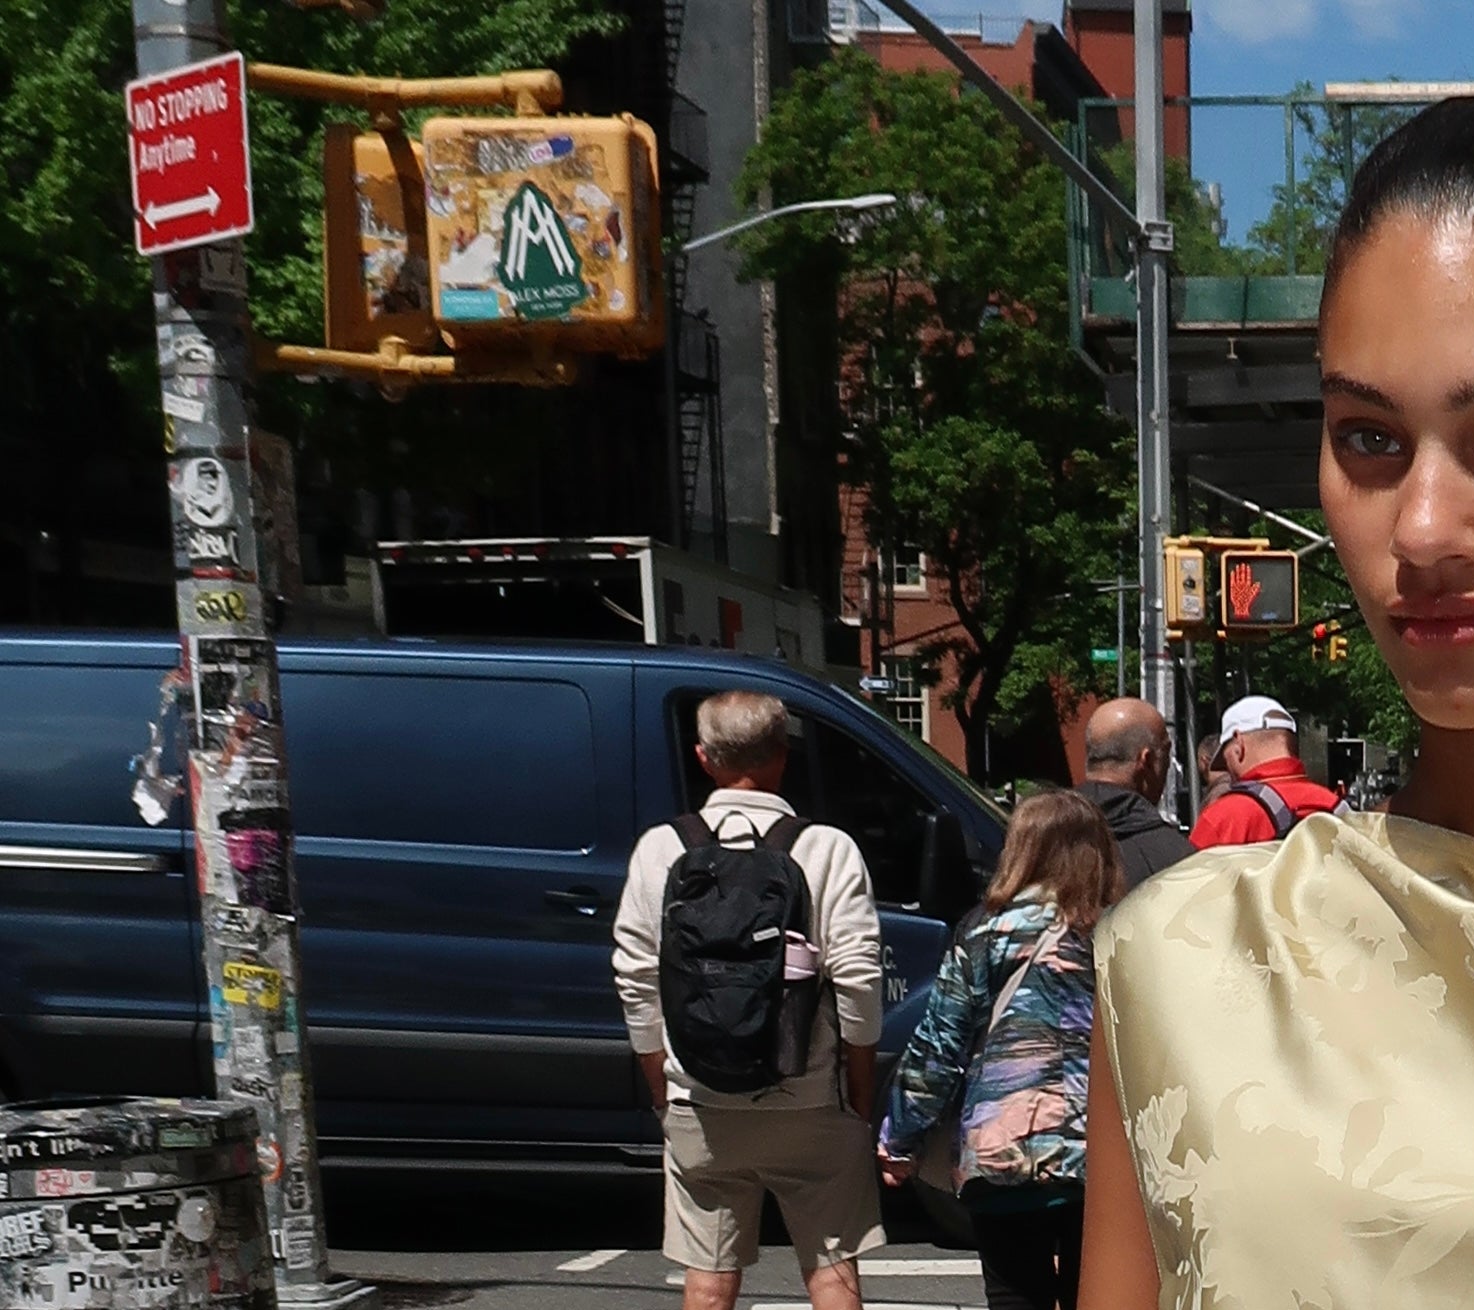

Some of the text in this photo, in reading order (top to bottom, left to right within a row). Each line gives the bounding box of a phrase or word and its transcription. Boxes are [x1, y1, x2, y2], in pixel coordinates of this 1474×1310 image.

[134, 77, 228, 131] NO STOPPING
[139, 134, 197, 175] Anytime
[543, 283, 580, 299] MOSS
